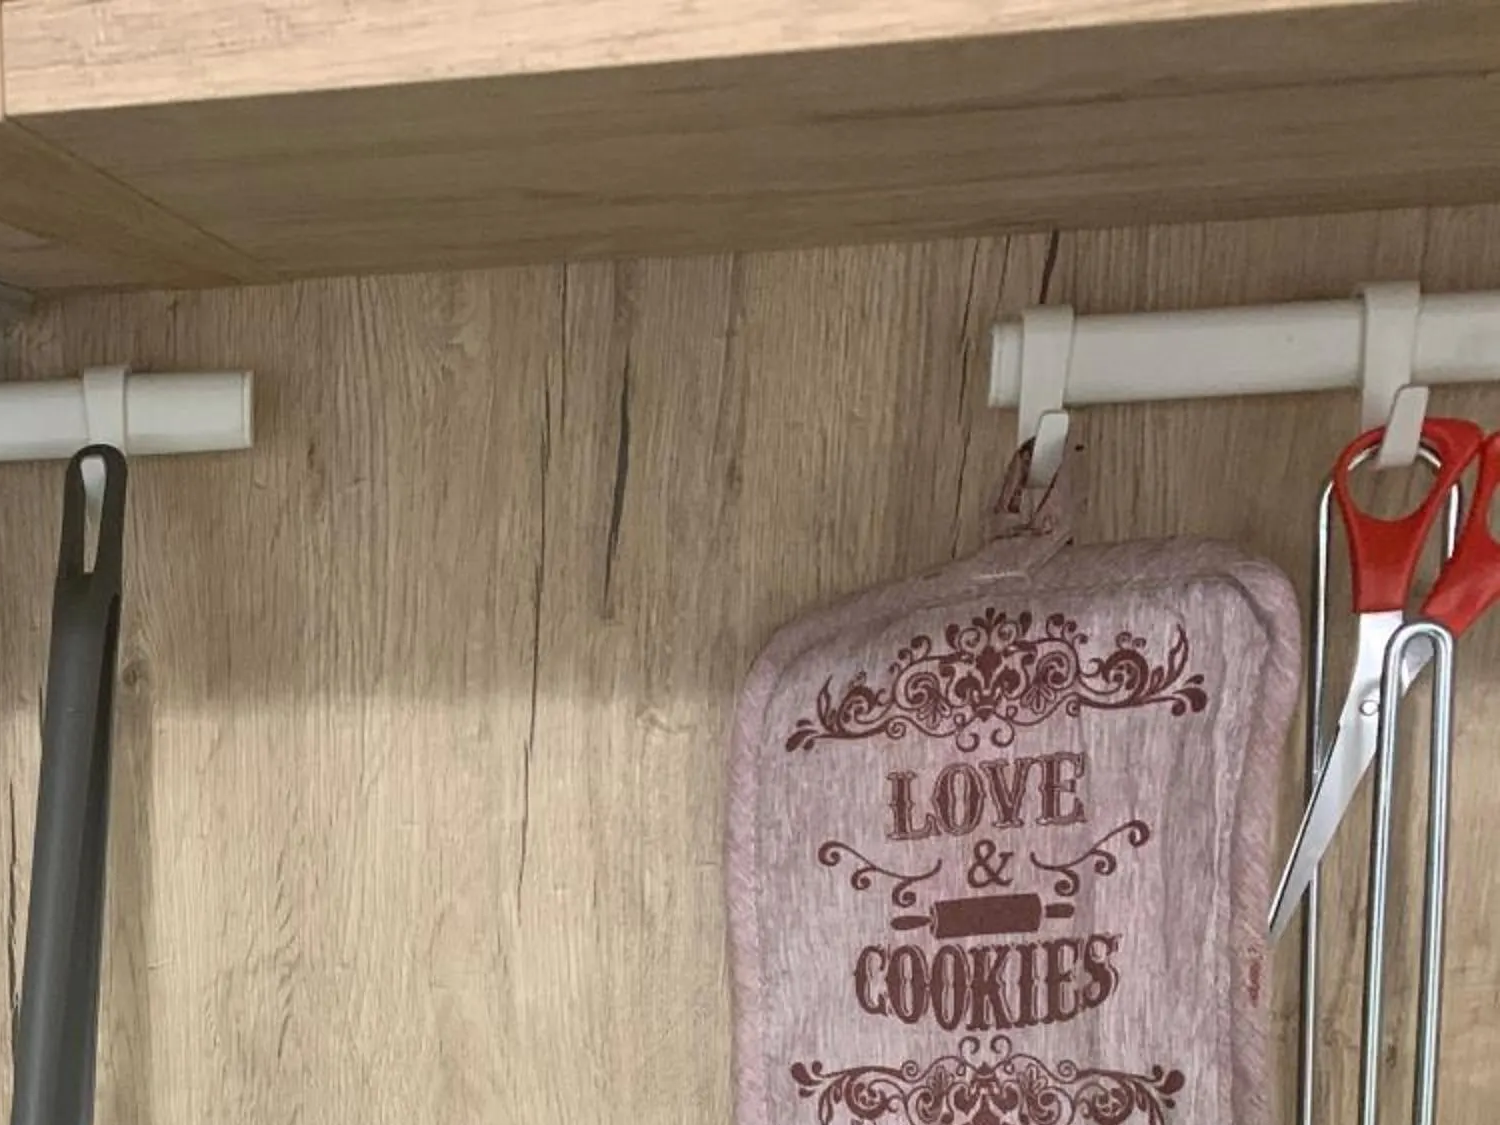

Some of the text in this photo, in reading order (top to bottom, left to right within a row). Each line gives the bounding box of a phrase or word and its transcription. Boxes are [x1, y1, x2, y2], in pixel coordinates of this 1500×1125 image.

[887, 752, 1088, 841] LOVE
[967, 841, 1013, 888] &
[855, 934, 1120, 1031] COOKIES
